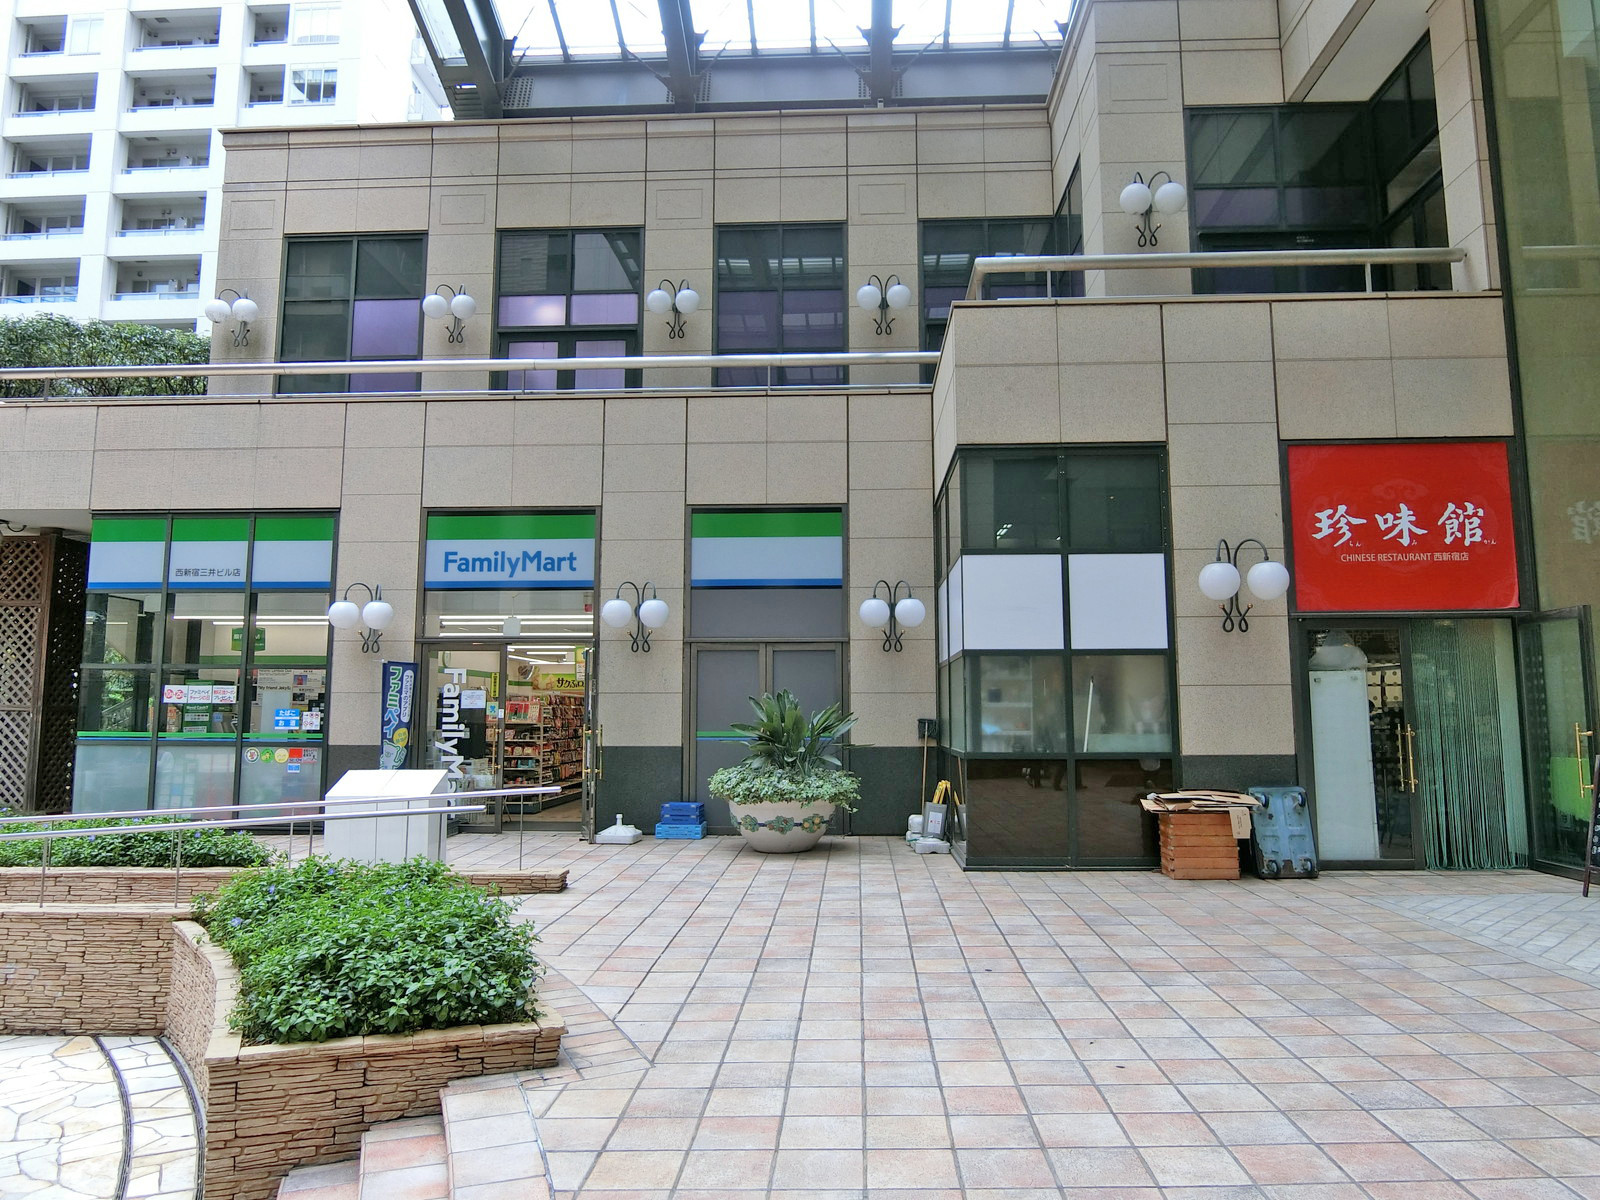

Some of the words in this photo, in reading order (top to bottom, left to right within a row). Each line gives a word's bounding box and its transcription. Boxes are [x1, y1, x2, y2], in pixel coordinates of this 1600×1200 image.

[1311, 502, 1484, 547] 珍味館
[175, 568, 241, 577] 西新宿三井ビル店
[443, 550, 577, 578] FamilyMart
[1340, 553, 1376, 562] CHINESE
[1377, 552, 1431, 562] RESTAURANT
[1433, 552, 1469, 561] 西新宿店
[383, 666, 403, 739] ファミペイ
[434, 668, 467, 819] FamilyM
